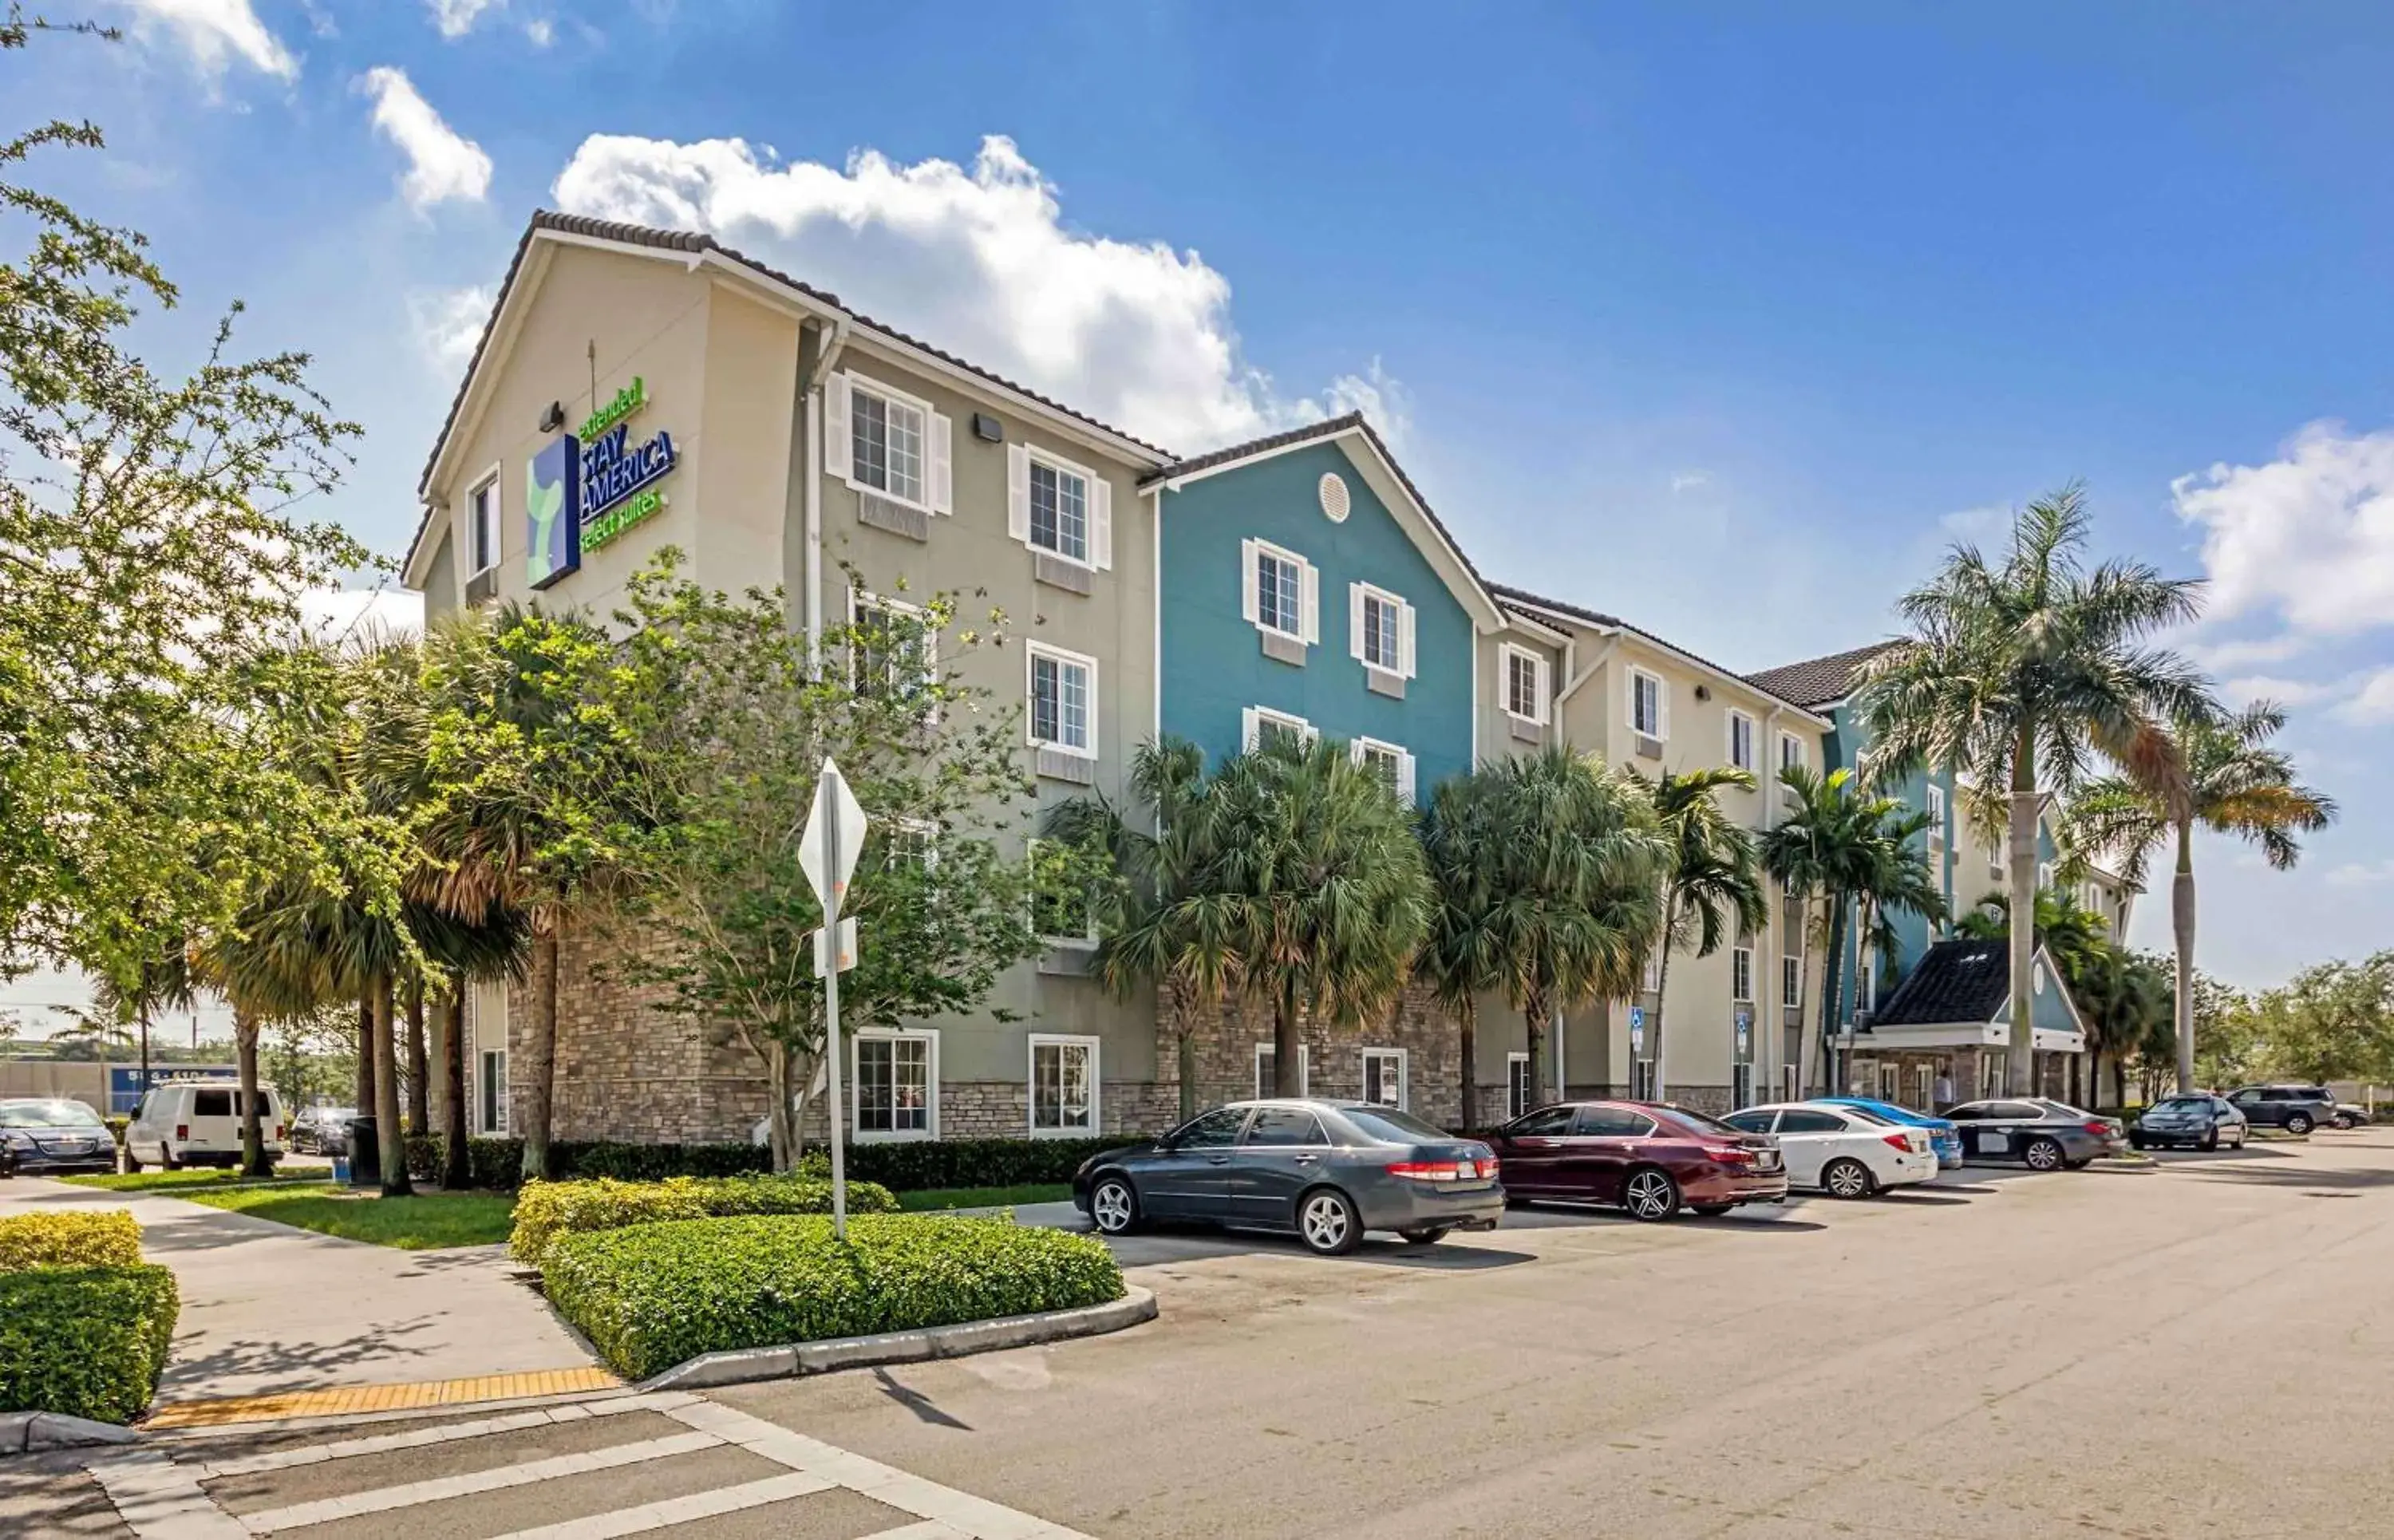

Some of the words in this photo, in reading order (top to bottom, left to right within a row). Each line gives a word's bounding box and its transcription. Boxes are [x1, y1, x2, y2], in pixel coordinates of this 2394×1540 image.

[579, 377, 642, 443] extended
[580, 424, 627, 484] STAY
[580, 431, 674, 518] AMERICA
[580, 511, 619, 553] select
[618, 488, 662, 528] suites
